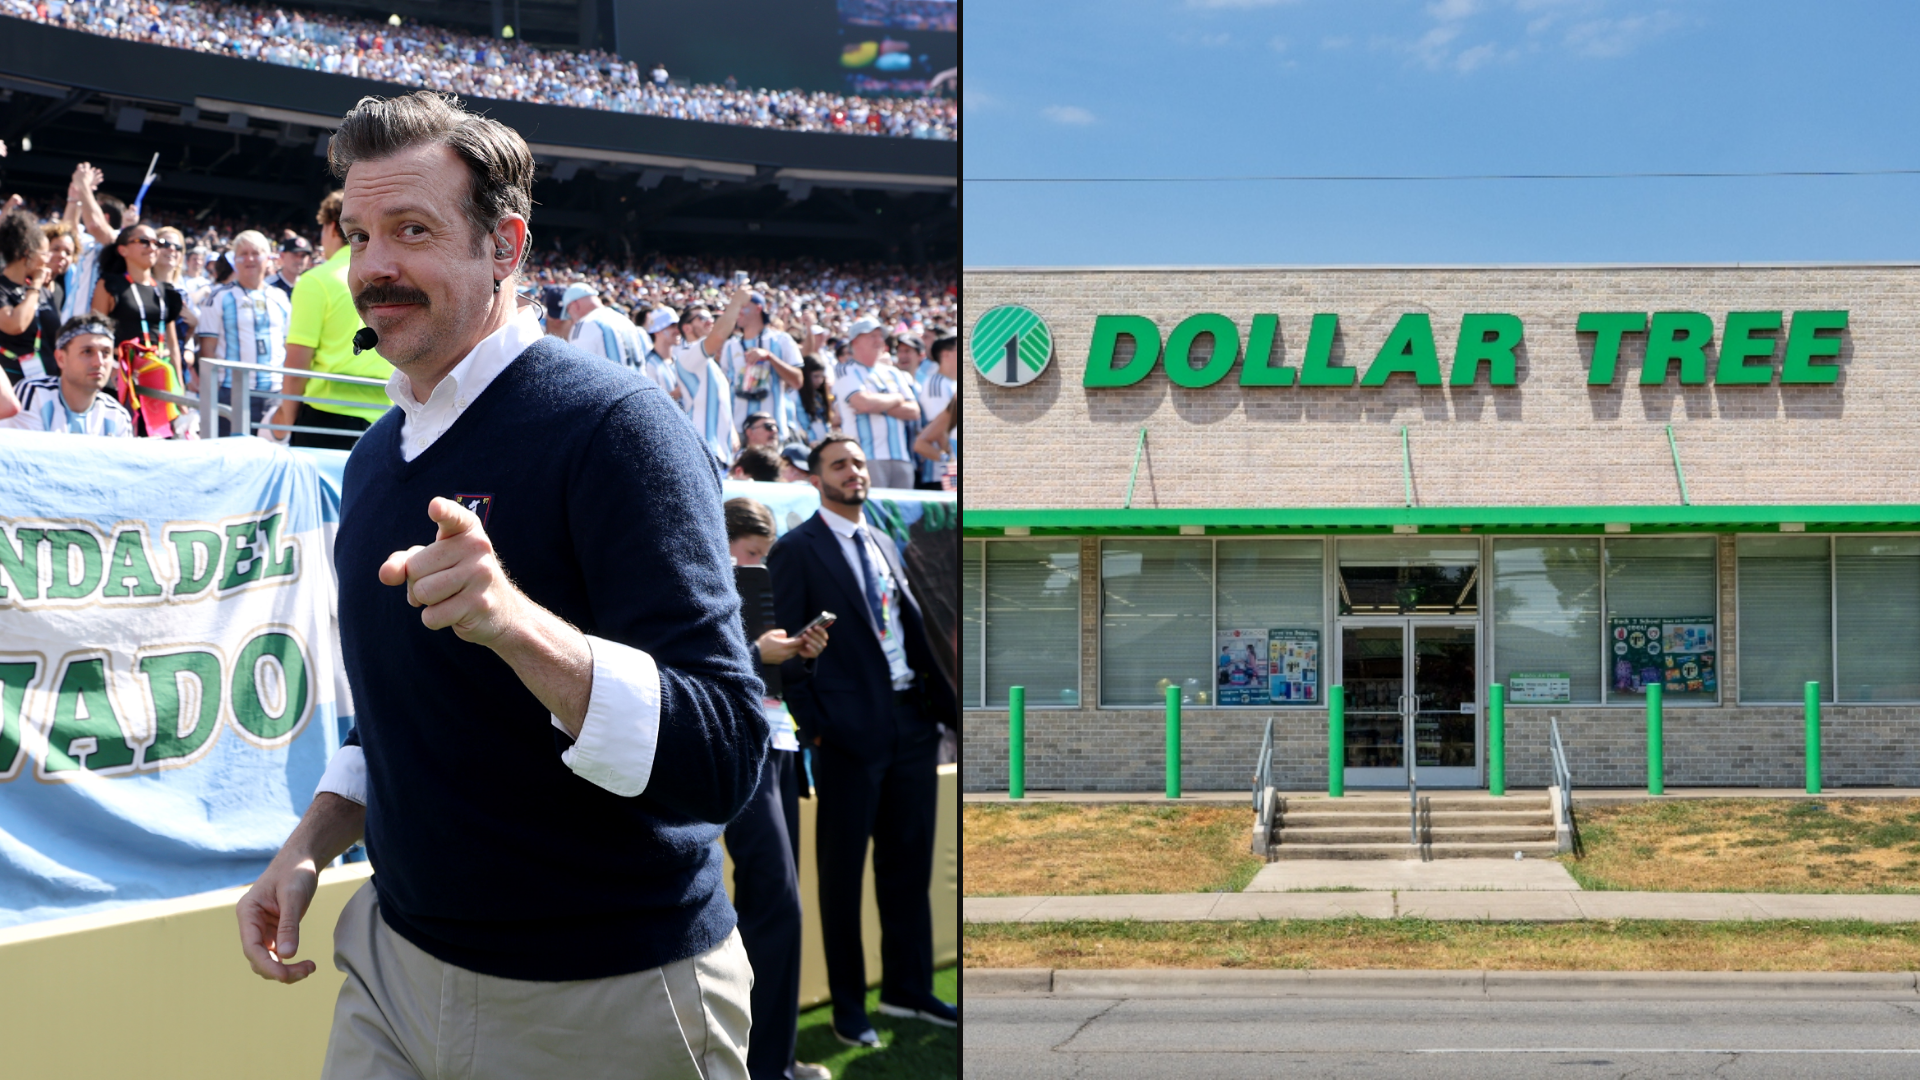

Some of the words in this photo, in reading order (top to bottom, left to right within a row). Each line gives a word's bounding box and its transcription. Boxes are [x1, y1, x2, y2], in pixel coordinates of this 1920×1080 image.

[1083, 312, 1524, 388] DOLLAR
[1576, 310, 1849, 386] TREE
[170, 513, 294, 592] DEL
